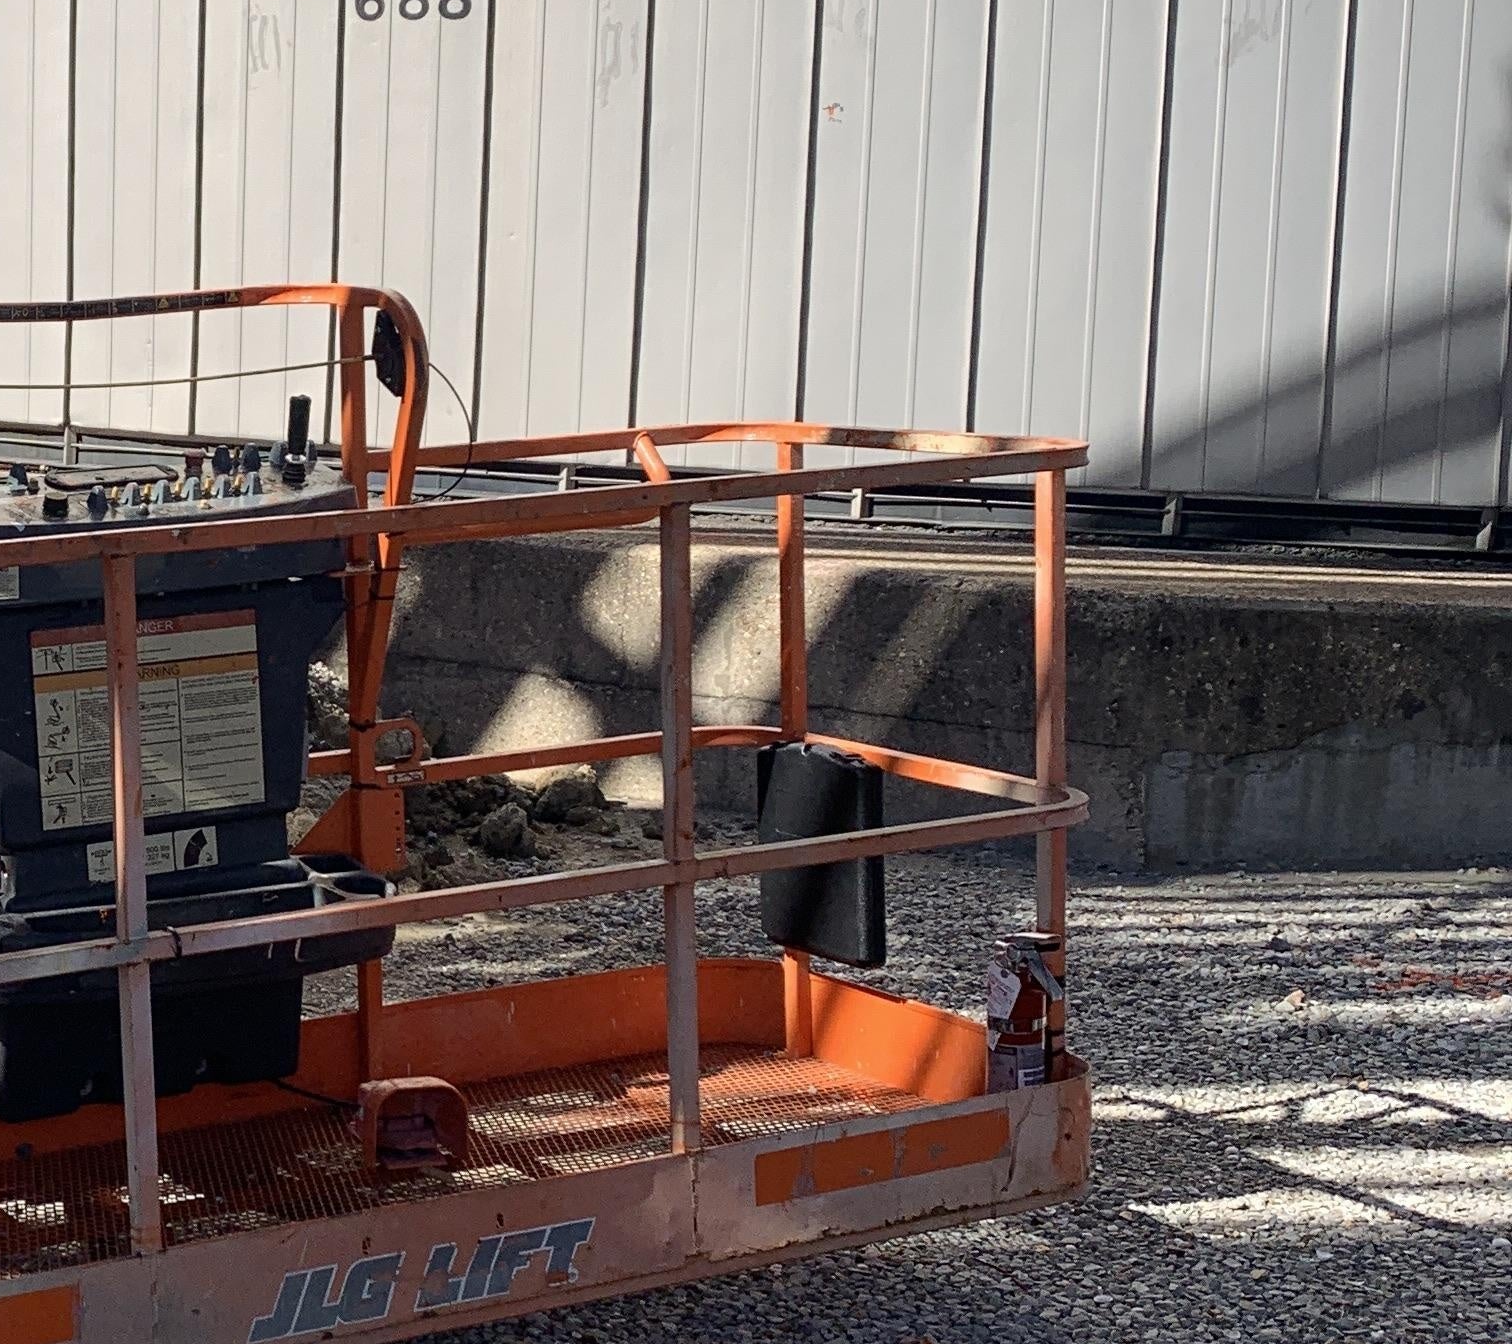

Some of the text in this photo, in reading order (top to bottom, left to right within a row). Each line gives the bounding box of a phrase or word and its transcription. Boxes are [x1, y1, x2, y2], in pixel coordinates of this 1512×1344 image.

[136, 619, 174, 633] NGER
[136, 664, 181, 679] RNING
[247, 1217, 596, 1344] JLG LIFT
